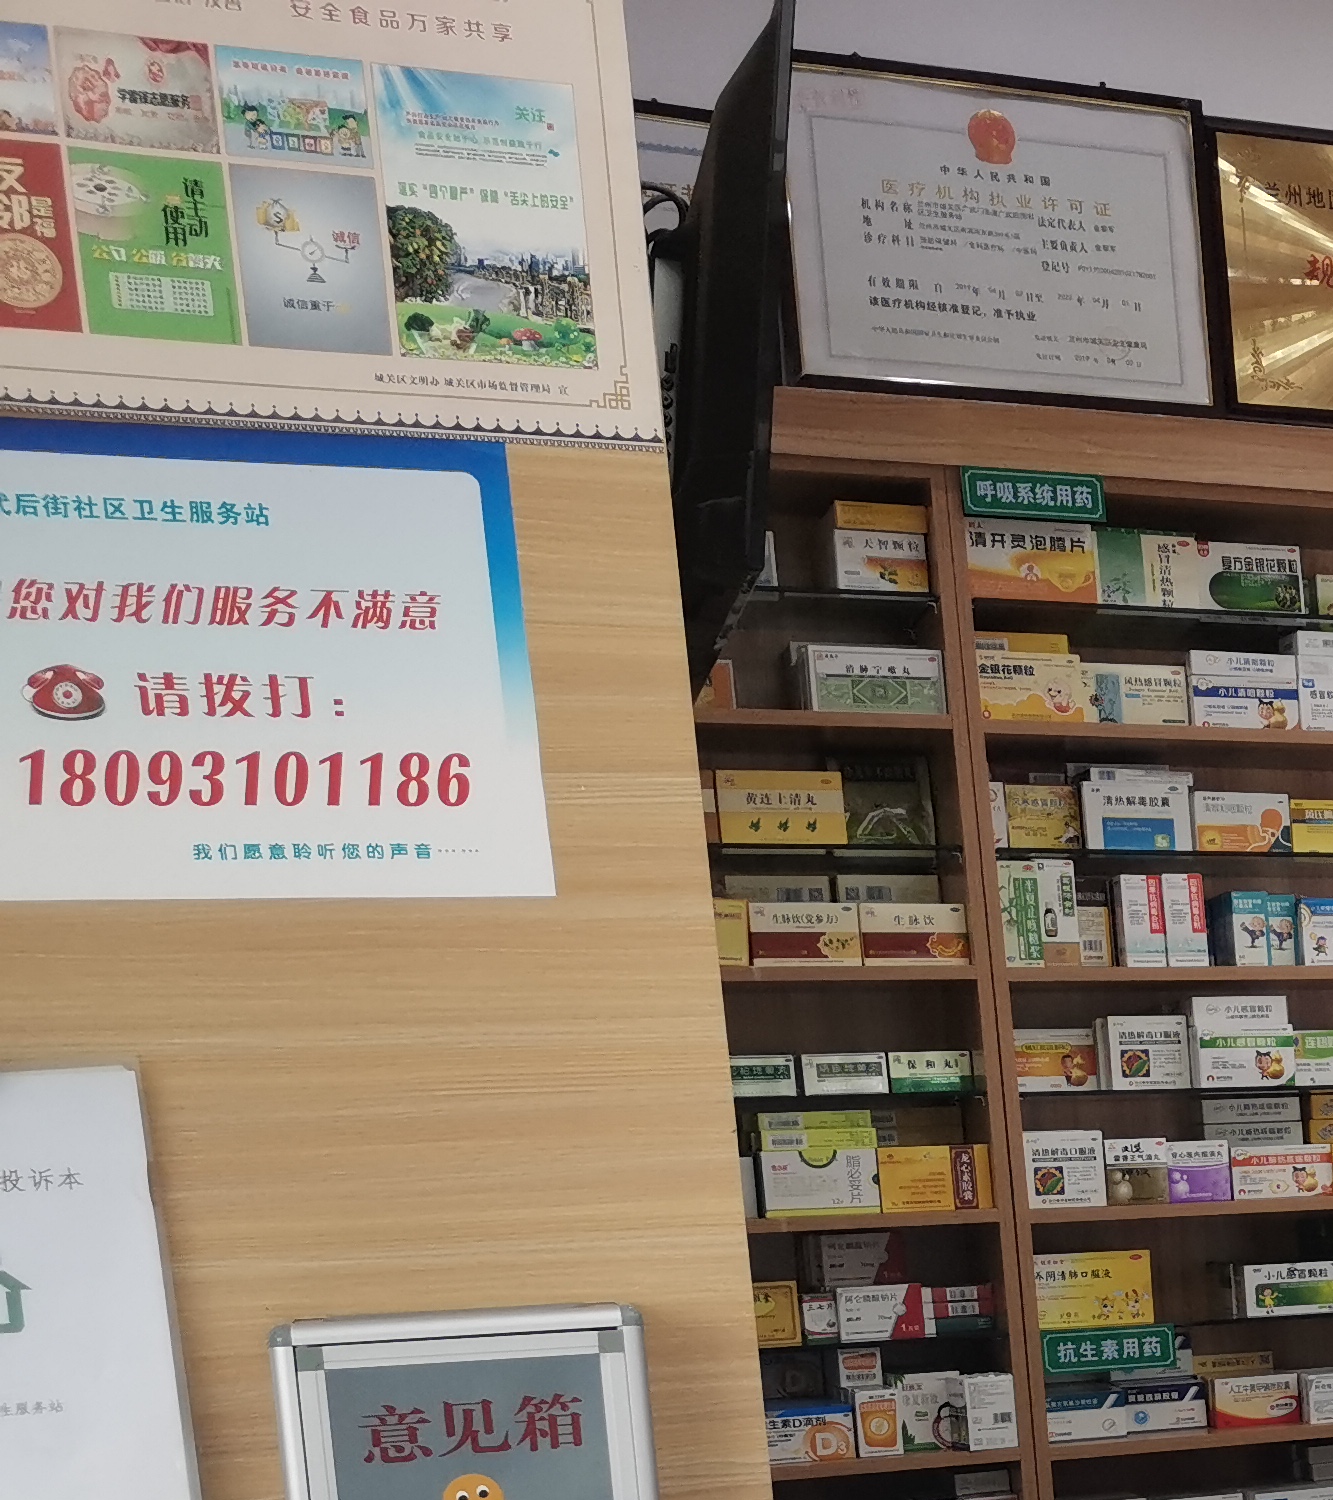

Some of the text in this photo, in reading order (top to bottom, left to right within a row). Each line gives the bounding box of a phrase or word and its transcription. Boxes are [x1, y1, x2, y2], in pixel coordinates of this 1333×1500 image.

[288, 2, 514, 43] 安全食品万家共享
[940, 165, 1051, 187] 中华人民共和国
[861, 197, 914, 214] 机构名称
[881, 178, 1113, 217] 医疗机构执业许可证
[161, 205, 188, 247] 使用
[1037, 216, 1086, 233] 法定代表人
[332, 231, 361, 246] 诚信
[863, 231, 915, 247] 诊疗科目
[1041, 238, 1089, 254] 主要负责人
[1041, 260, 1071, 274] 登记号
[868, 276, 920, 291] 有效期限
[869, 296, 1037, 322] 该医疗机构经核准登记，准予执业
[374, 372, 440, 388] 城关区文明办
[444, 376, 551, 396] 城关区市场监督管理局
[976, 479, 1094, 509] 呼吸系统用药
[969, 531, 1087, 555] 清开灵泡腾片
[1156, 542, 1175, 609] 感冒清热颗粒
[1221, 554, 1298, 574] 复方金银花颗粒
[6, 578, 442, 632] 您对我们服务不满意
[978, 662, 1035, 677] 金银花颗粒
[134, 670, 347, 720] 请拨打：
[18, 747, 472, 808] 18093101186
[746, 790, 818, 807] 黄连上清丸
[1102, 795, 1171, 808] 清热解毒胶囊
[894, 911, 935, 927] 生脉饮
[0, 1166, 84, 1194] 投诉本
[1263, 1267, 1329, 1281] 小儿感冒颗粒
[1056, 1335, 1161, 1363] 抗生素用药
[358, 1393, 585, 1467] 意见箱
